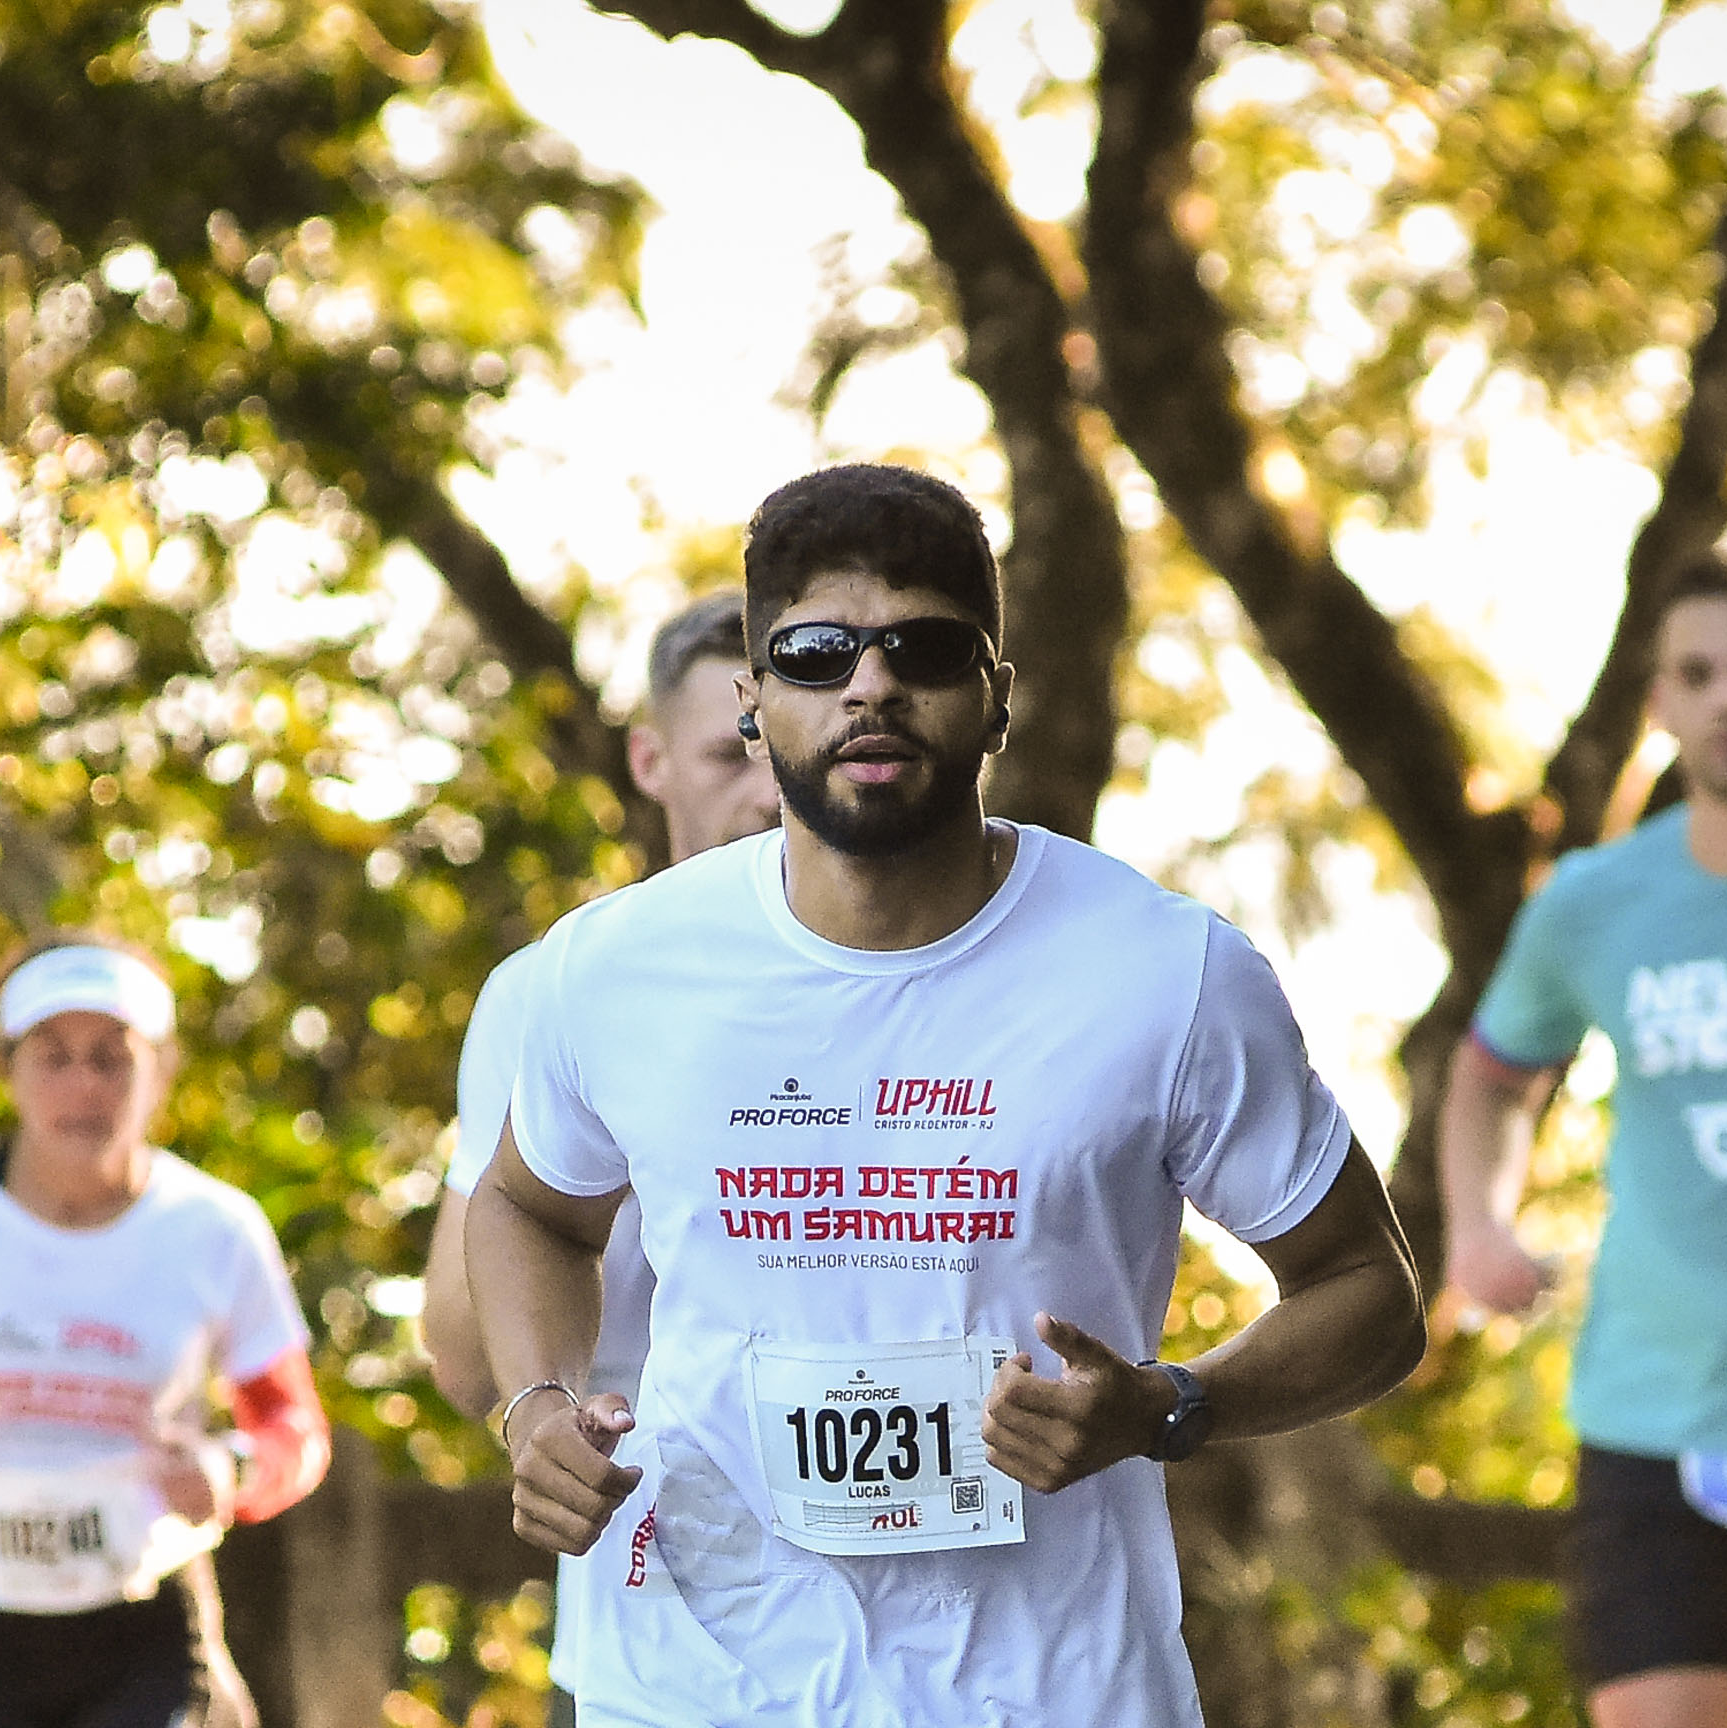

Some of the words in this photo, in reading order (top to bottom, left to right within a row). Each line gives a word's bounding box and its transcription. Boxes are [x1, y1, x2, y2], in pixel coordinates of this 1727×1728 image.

[874, 1120, 911, 1129] CRISTO
[914, 1120, 968, 1129] REDENTOR
[979, 1120, 993, 1129] RJ
[715, 1167, 843, 1198] NADA
[858, 1155, 1018, 1199] DETÉM
[720, 1209, 791, 1240] UM
[804, 1207, 1015, 1243] SAMURAI
[757, 1254, 783, 1269] SUA
[787, 1254, 846, 1268] MELHOR
[851, 1251, 907, 1269] VERSÃO
[912, 1254, 945, 1271] ESTÁ
[949, 1257, 979, 1274] AQUI
[787, 1402, 952, 1483] 10231
[848, 1484, 890, 1498] LUCAS
